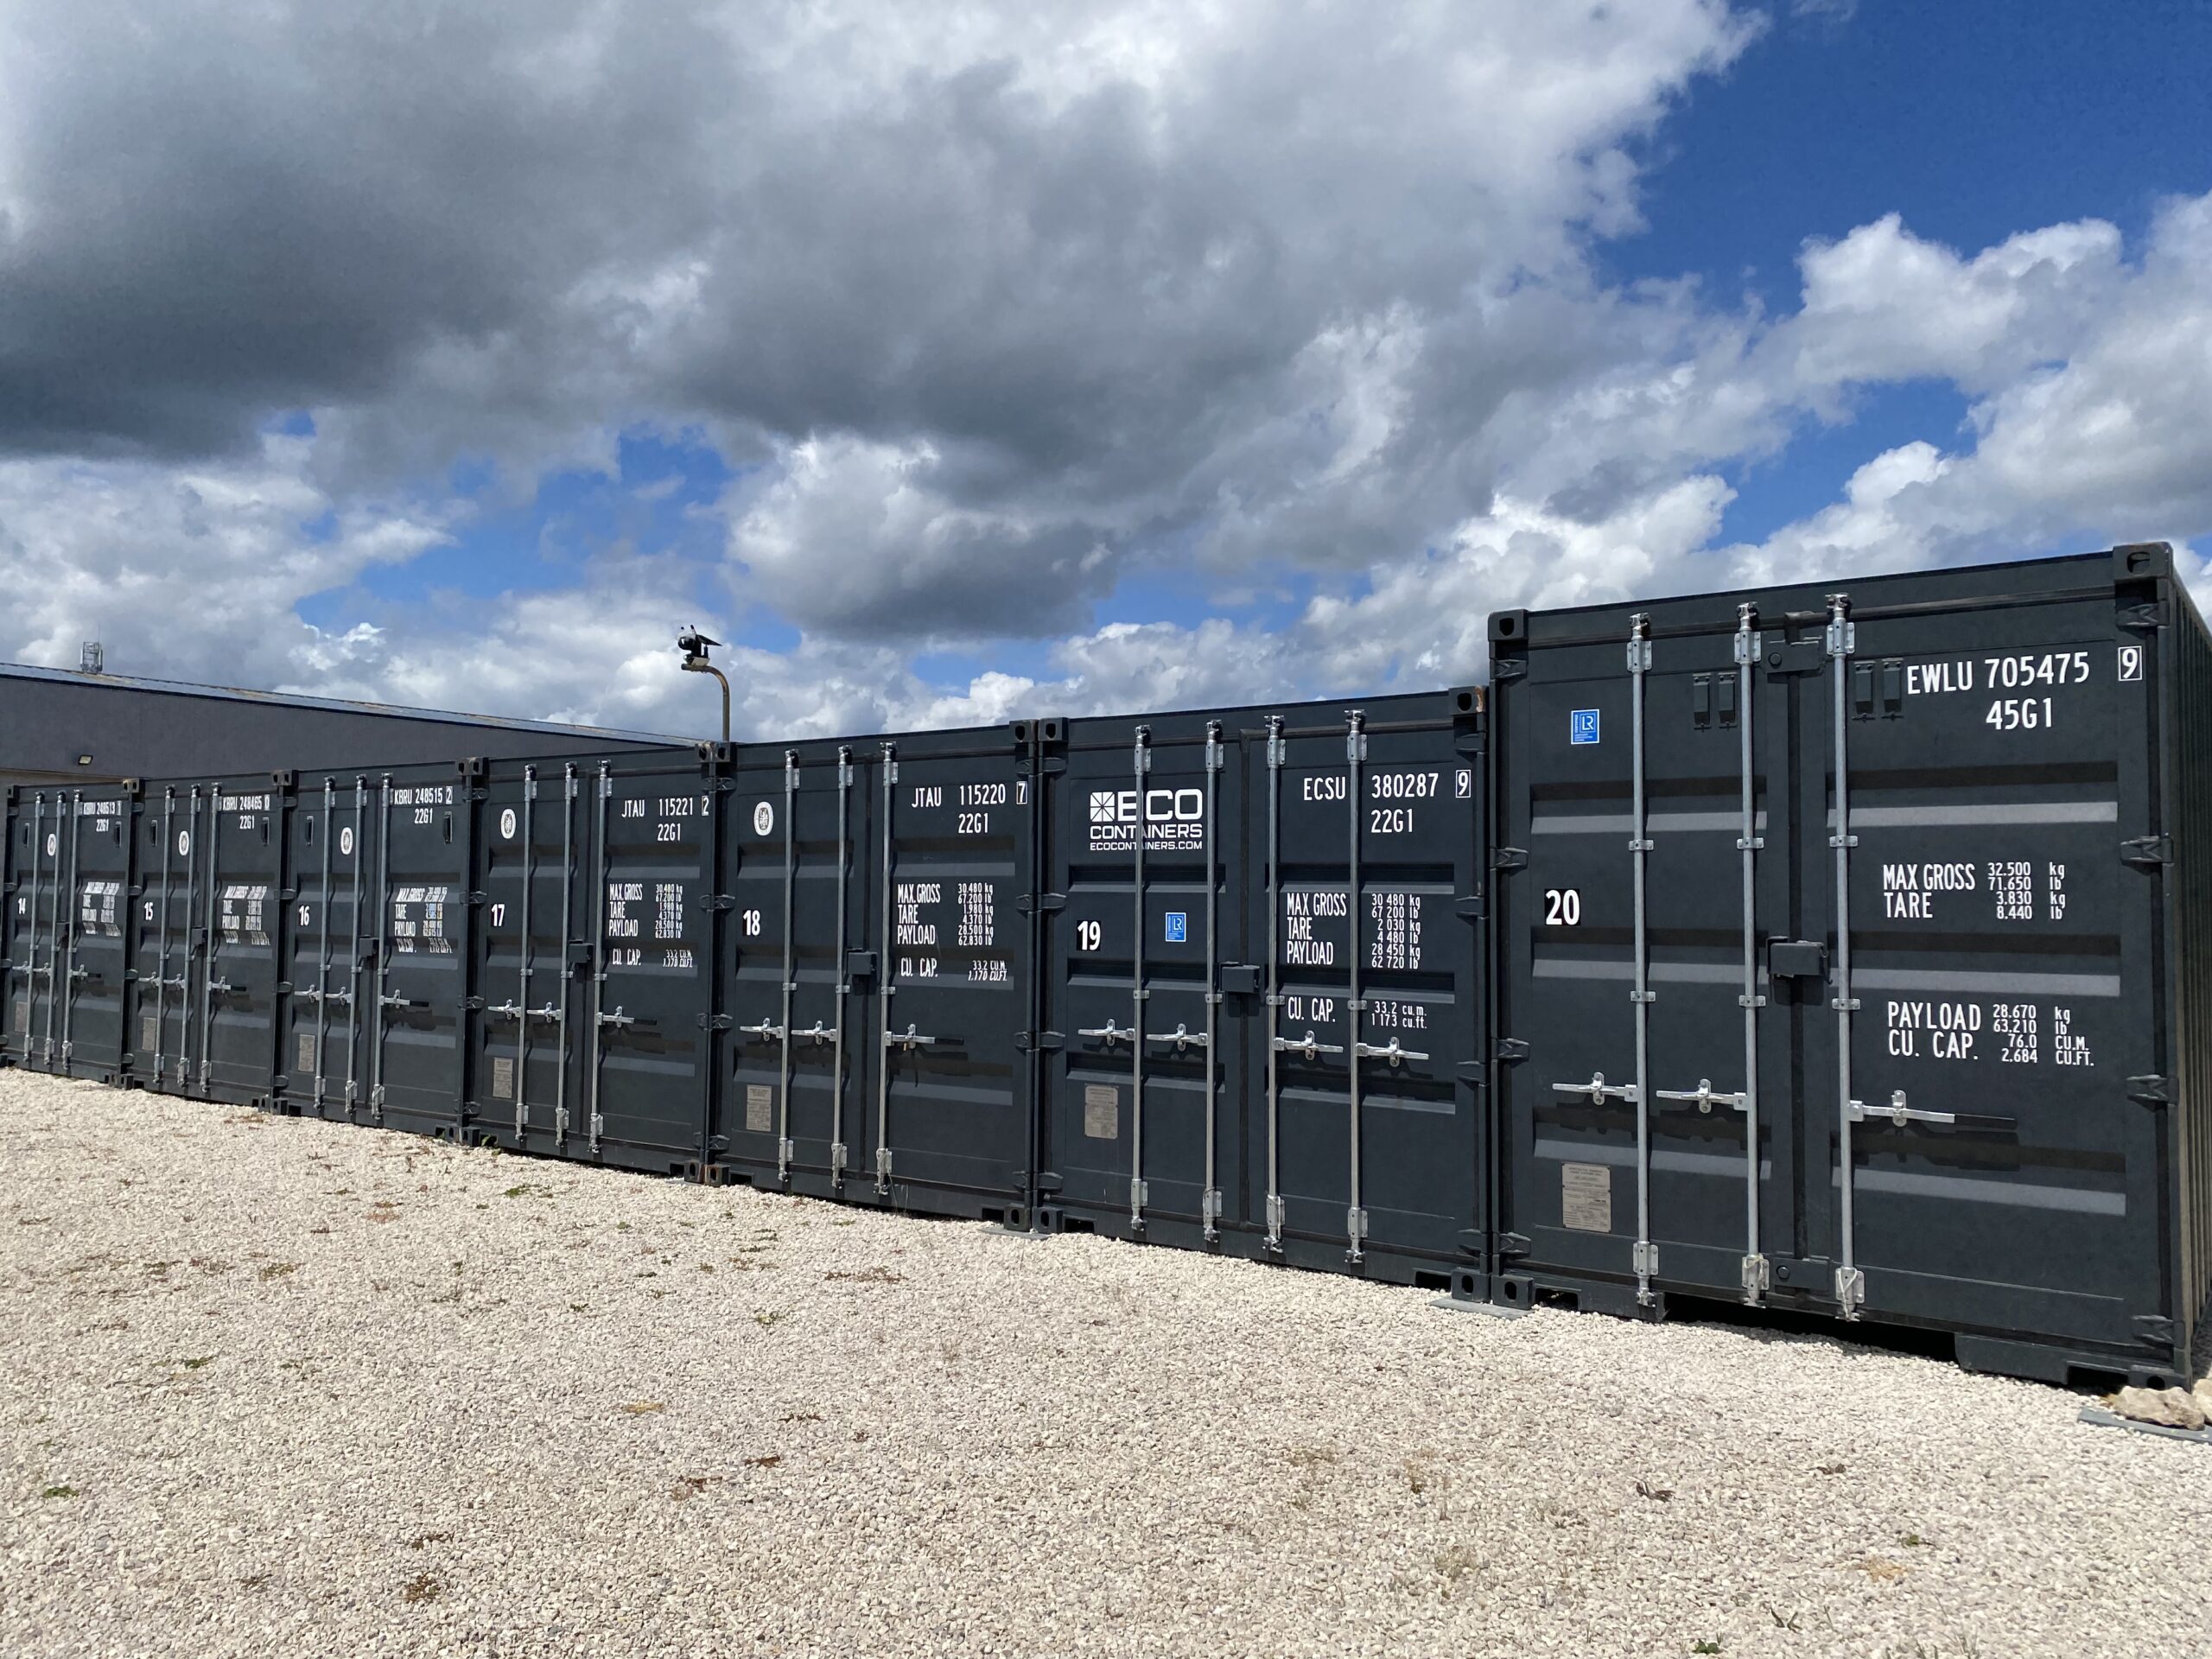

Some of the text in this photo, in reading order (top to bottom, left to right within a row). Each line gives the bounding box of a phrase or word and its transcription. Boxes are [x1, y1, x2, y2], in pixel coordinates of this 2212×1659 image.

[1907, 647, 2139, 695] EWLU 705475 9
[1986, 697, 2052, 730] 45G1
[912, 782, 1027, 808] JTAU 115220 7
[1303, 771, 1470, 801] ECSU 380287 9
[394, 788, 413, 804] KBRU
[415, 787, 443, 804] 248515
[621, 796, 709, 818] JTAU 115221 2
[1117, 788, 1203, 822] ECO
[414, 808, 433, 823] 22G1
[958, 812, 988, 834] 22G1
[1370, 808, 1413, 834] 22G1
[657, 823, 681, 842] 22G1
[1090, 841, 1203, 851] ECOCONTINERS.COM
[1883, 863, 1976, 890] MAX GROSS
[1987, 861, 2065, 880] 32.500 kg
[957, 882, 994, 895] 30.480 kg
[1988, 876, 2062, 891] 71.650 lb
[957, 893, 982, 905] 67.200
[1287, 893, 1347, 917] MAX GROSS
[1409, 894, 1421, 909] kg
[1545, 889, 1580, 925] 20
[1884, 892, 1933, 918] TARE
[1996, 891, 2066, 908] 3.830 kg
[144, 902, 153, 920] 15
[299, 905, 310, 926] 16
[492, 904, 505, 927] 17
[609, 901, 626, 918] TARE
[898, 904, 918, 925] TARE
[963, 904, 994, 917] 1.980 kg
[1409, 906, 1419, 919] lb
[1996, 906, 2063, 919] 8.440 lb
[608, 919, 639, 937] PAYLOAD
[742, 910, 760, 936] 18
[963, 914, 982, 925] 4.370
[1287, 917, 1313, 940] TARE
[1409, 919, 1421, 935] kg
[897, 925, 936, 945] PAYLOAD
[958, 925, 994, 938] 28.500 kg
[958, 935, 982, 946] 62.830
[1077, 920, 1101, 950] 19
[1409, 932, 1419, 944] lb
[626, 948, 641, 966] CAP.
[1287, 940, 1333, 965] PAYLOAD
[1409, 944, 1421, 960] kg
[900, 957, 938, 977] CU. CAP.
[972, 960, 988, 970] 33.2
[1409, 957, 1419, 969] lb
[968, 970, 988, 981] 1.170
[1287, 996, 1336, 1023] CU. CAP.
[1374, 1001, 1427, 1016] 33.2 cu.m.
[1887, 1001, 1981, 1032] PAYLOAD
[1993, 1004, 2070, 1023] 28.670 kg
[1402, 1015, 1427, 1029] cu.ft.
[1993, 1019, 2068, 1034] 63.210 lb
[1889, 1030, 1979, 1060] CU. CAP.
[2008, 1033, 2089, 1051] 76.0 CU.M.
[2001, 1048, 2094, 1066] 2.684 CU.FT.
